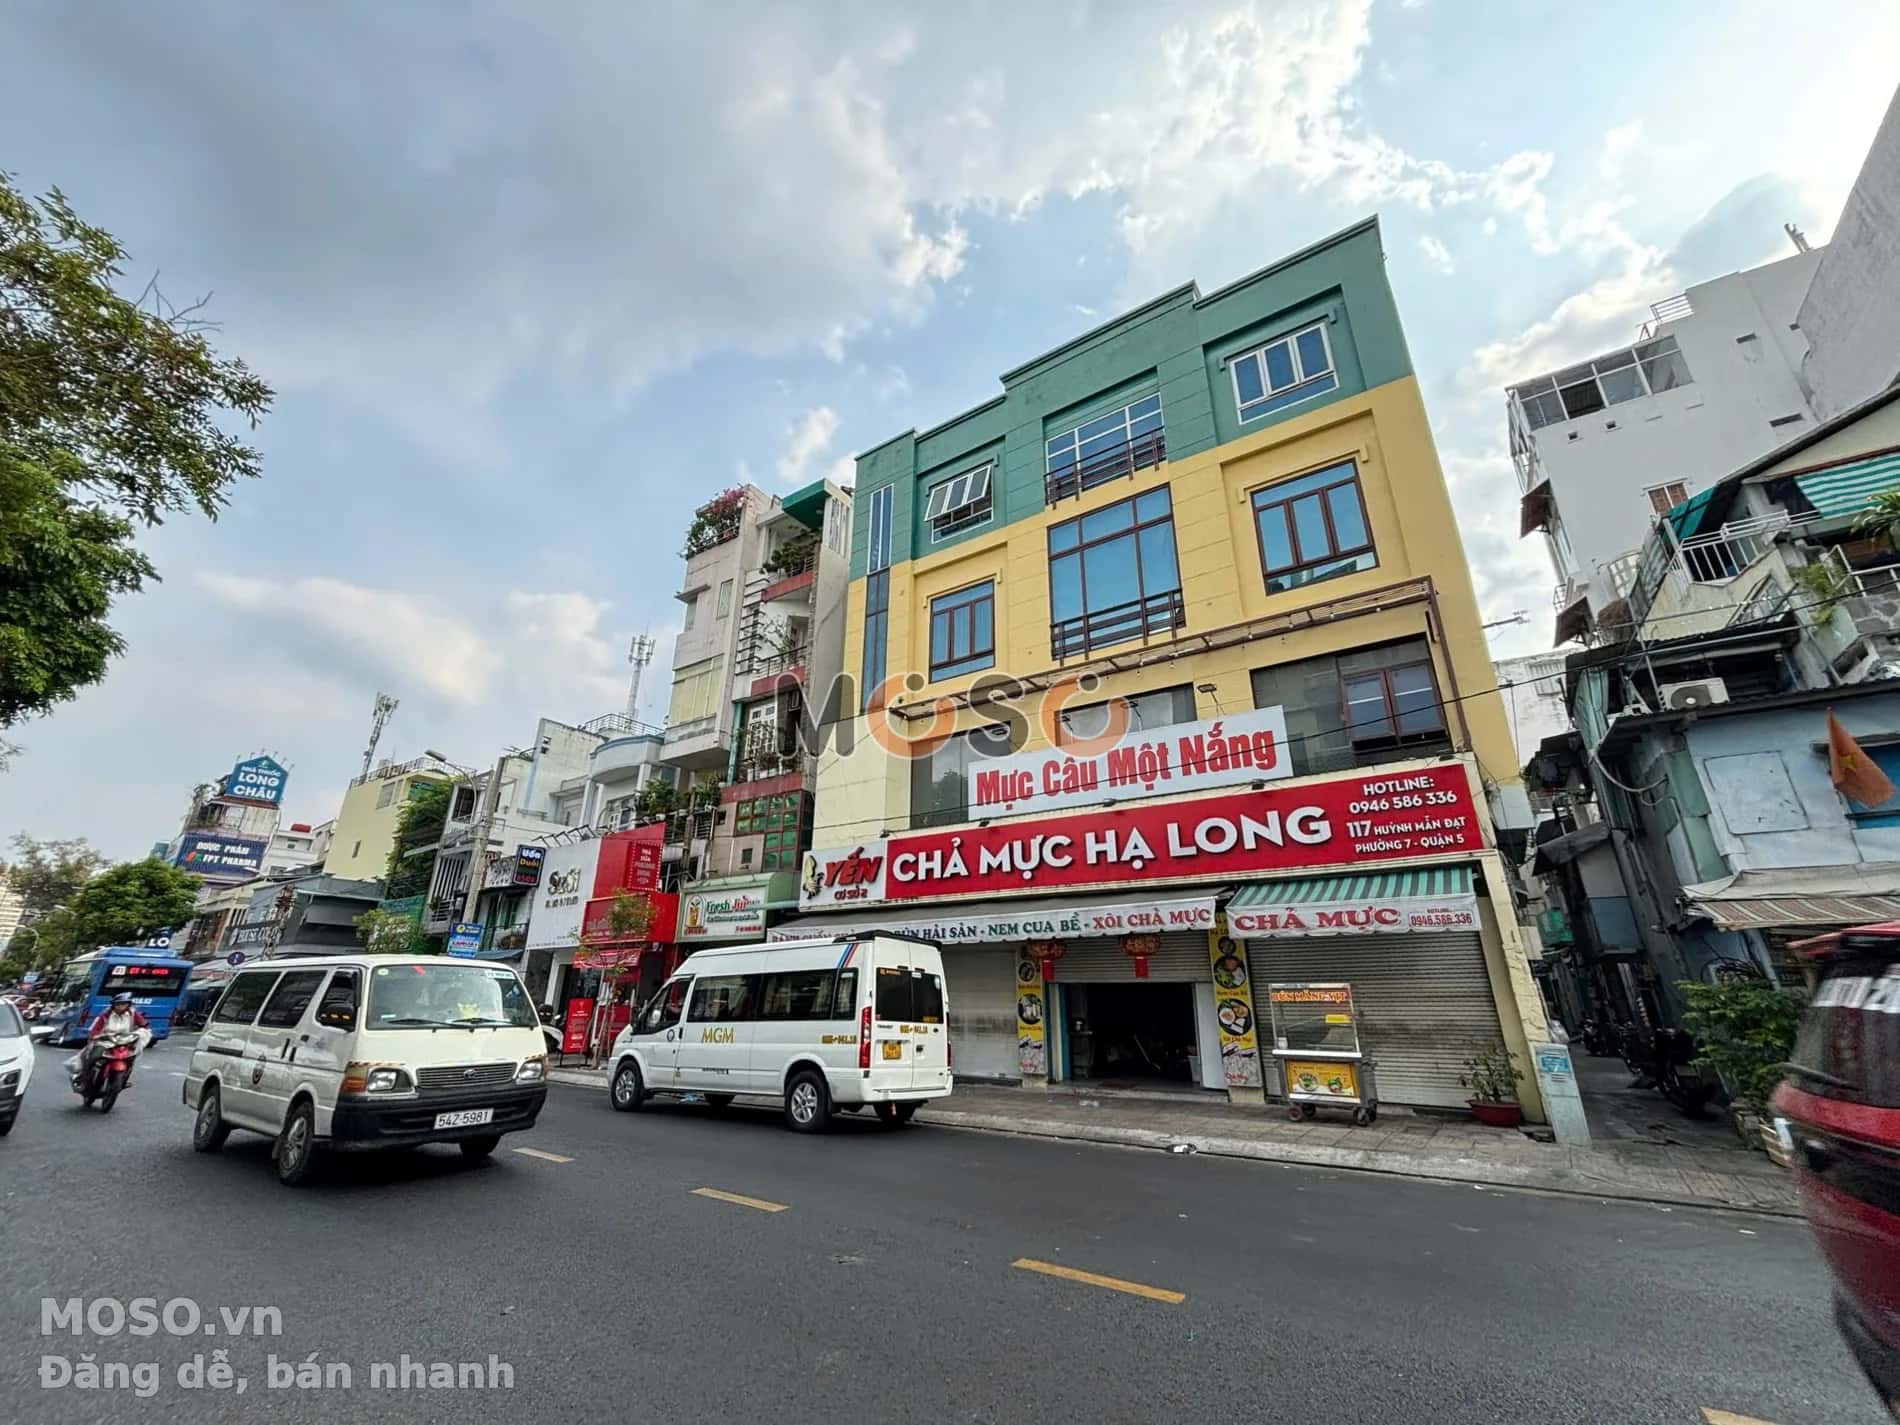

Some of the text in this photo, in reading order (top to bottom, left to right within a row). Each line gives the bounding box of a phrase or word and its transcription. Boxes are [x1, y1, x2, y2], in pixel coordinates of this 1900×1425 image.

[976, 722, 1278, 811] Mực Câu Một Nắng
[238, 772, 279, 787] LONG
[1363, 776, 1435, 796] HOTLINE:
[233, 785, 277, 799] CHÂU
[1349, 790, 1458, 814] 0946 586 336
[1346, 820, 1371, 838] 117
[1444, 816, 1466, 830] ĐẠT
[892, 806, 1333, 882] CHẢ MỰC HẠ LONG
[1355, 838, 1403, 853] PHƯỜNG
[1404, 839, 1411, 849] 7
[1420, 833, 1454, 848] QUẬN
[1456, 834, 1465, 844] 5
[824, 846, 883, 888] YẾN
[707, 899, 730, 912] Fresh
[923, 924, 946, 939] HẢI
[949, 922, 976, 938] SẢN
[988, 922, 1018, 936] NEM
[1022, 920, 1054, 934] CUA
[1093, 912, 1122, 930] XÔI
[1169, 906, 1211, 927] MỰC
[1235, 905, 1402, 931] CHẢ MỰC
[701, 1027, 734, 1044] MGM
